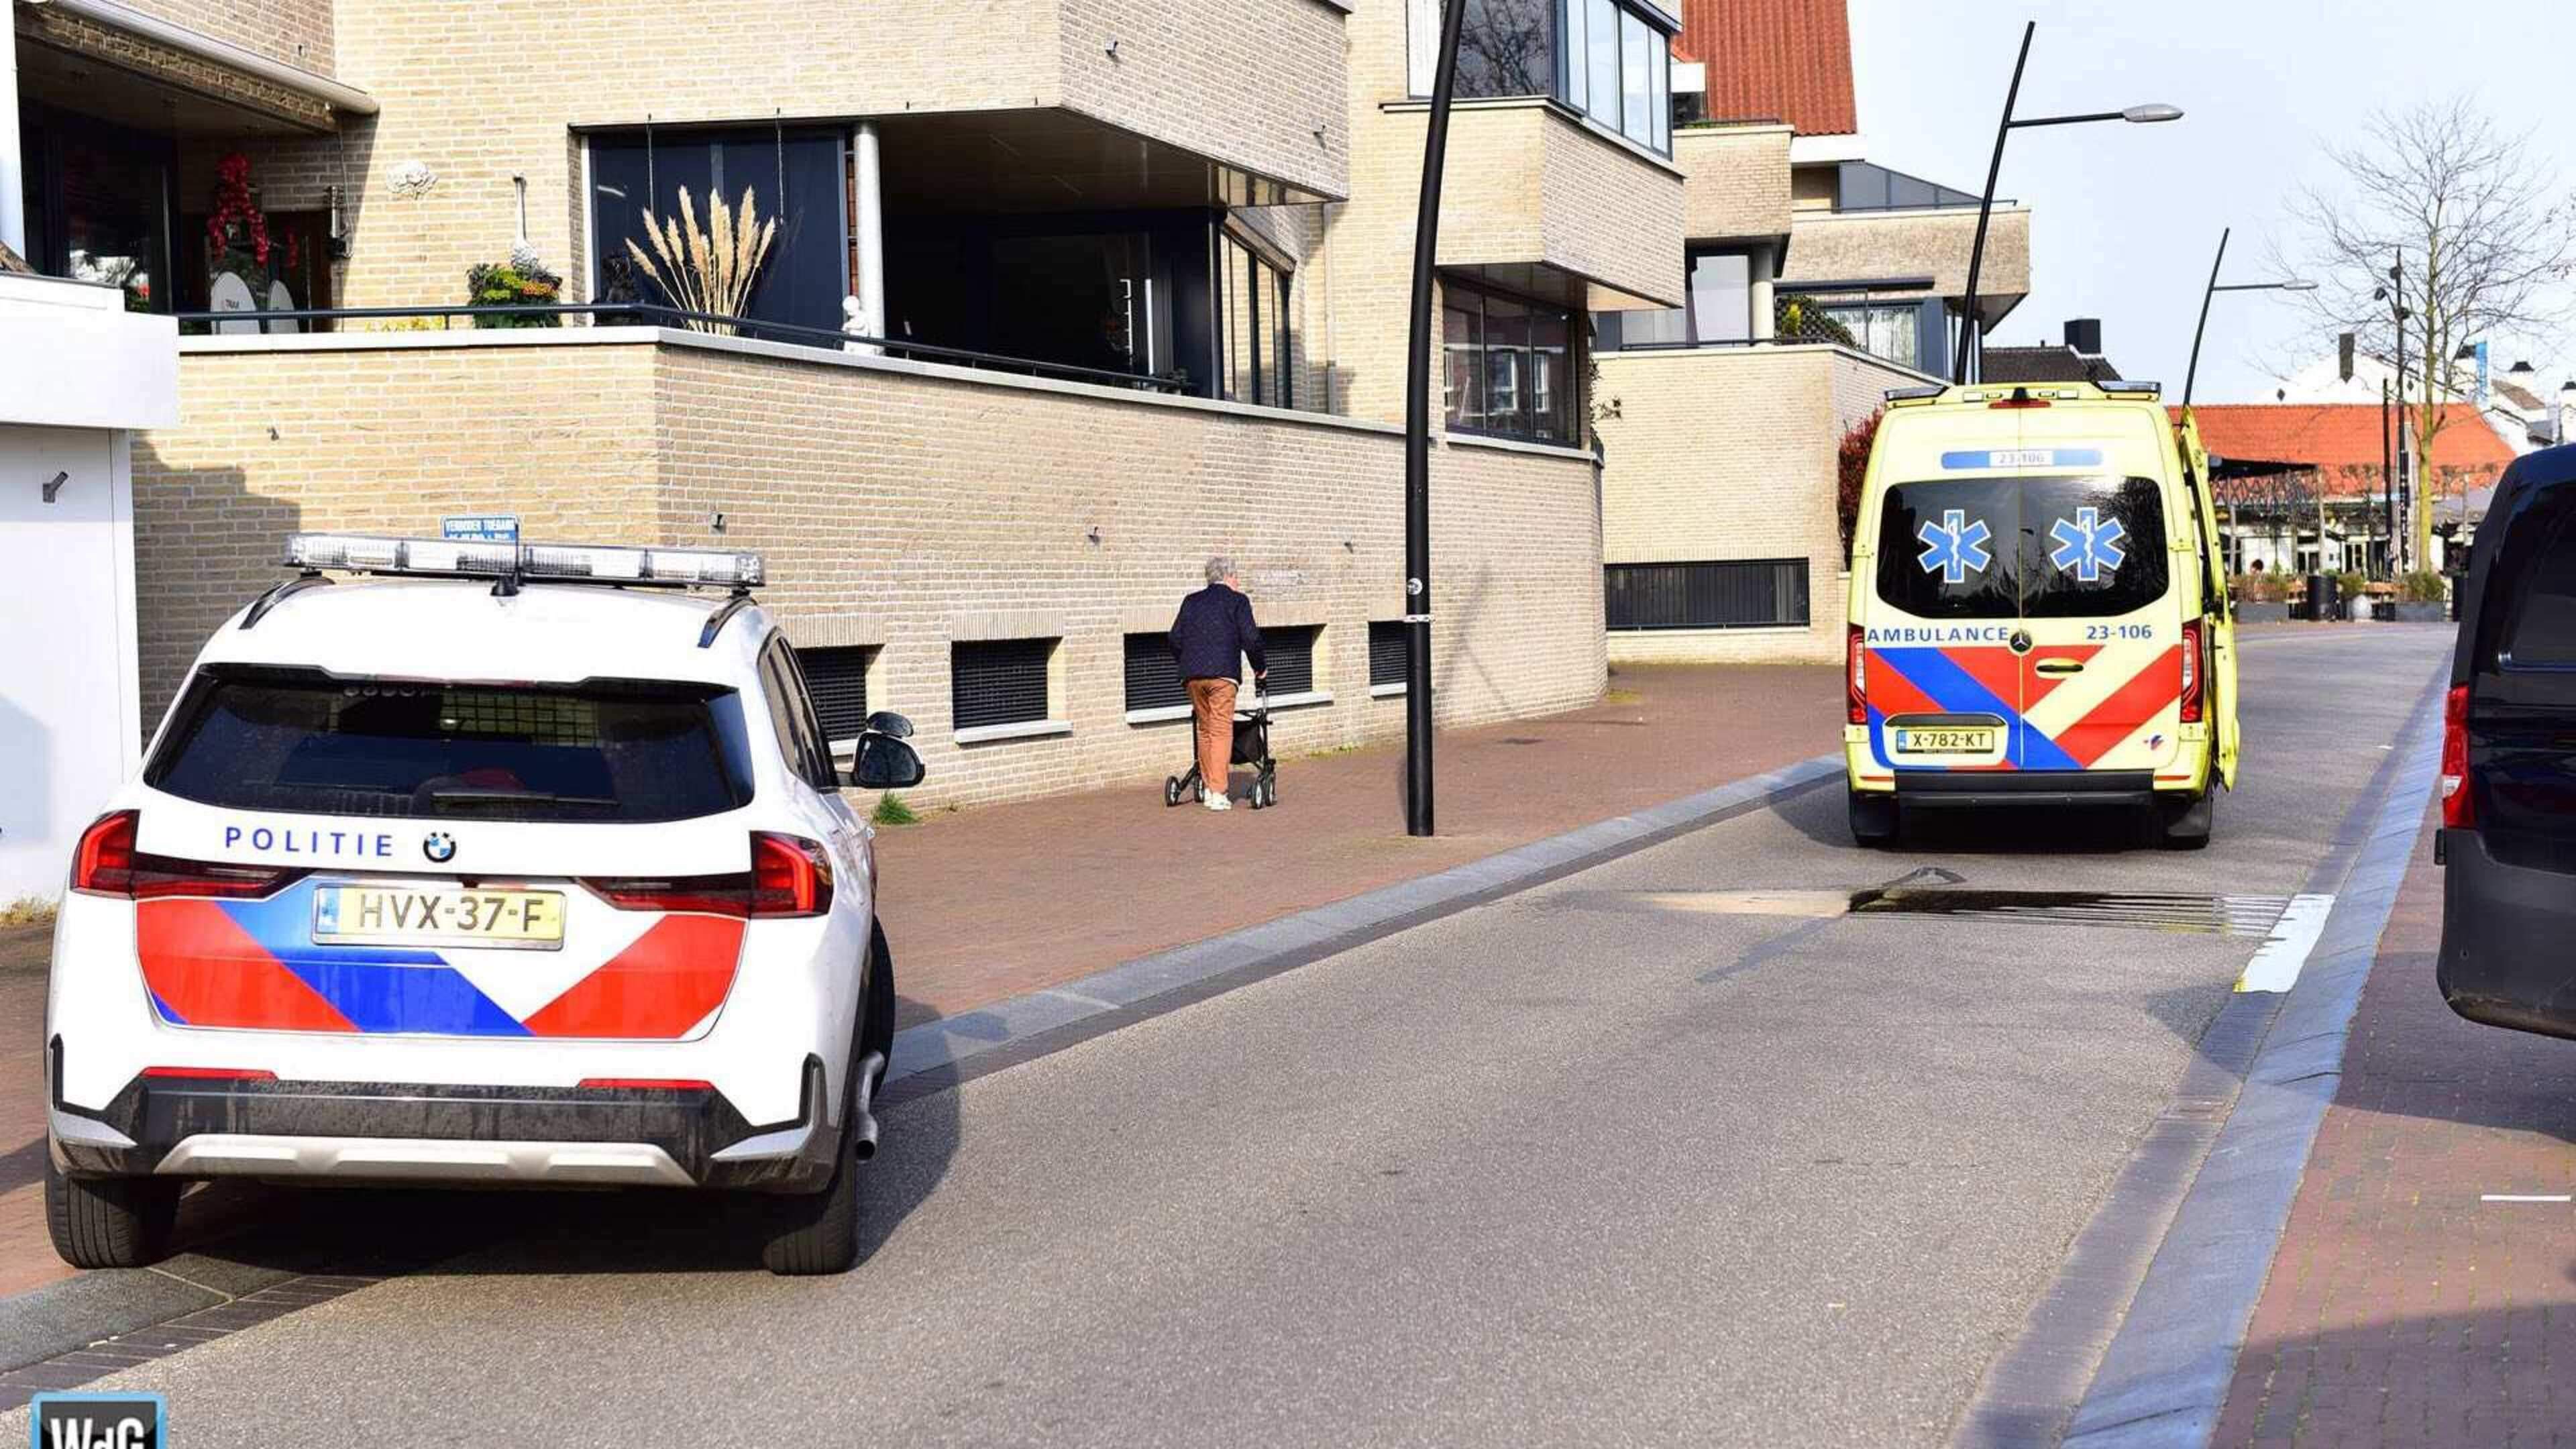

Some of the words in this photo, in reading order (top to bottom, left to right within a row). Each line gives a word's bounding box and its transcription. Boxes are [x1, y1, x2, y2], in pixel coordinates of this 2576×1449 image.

[1867, 627, 2009, 641] AMBULANCE
[2086, 625, 2152, 639] 23-106
[1913, 733, 1986, 747] X-782-KT
[225, 826, 393, 857] POLITIE
[359, 893, 543, 932] HVX-37-F
